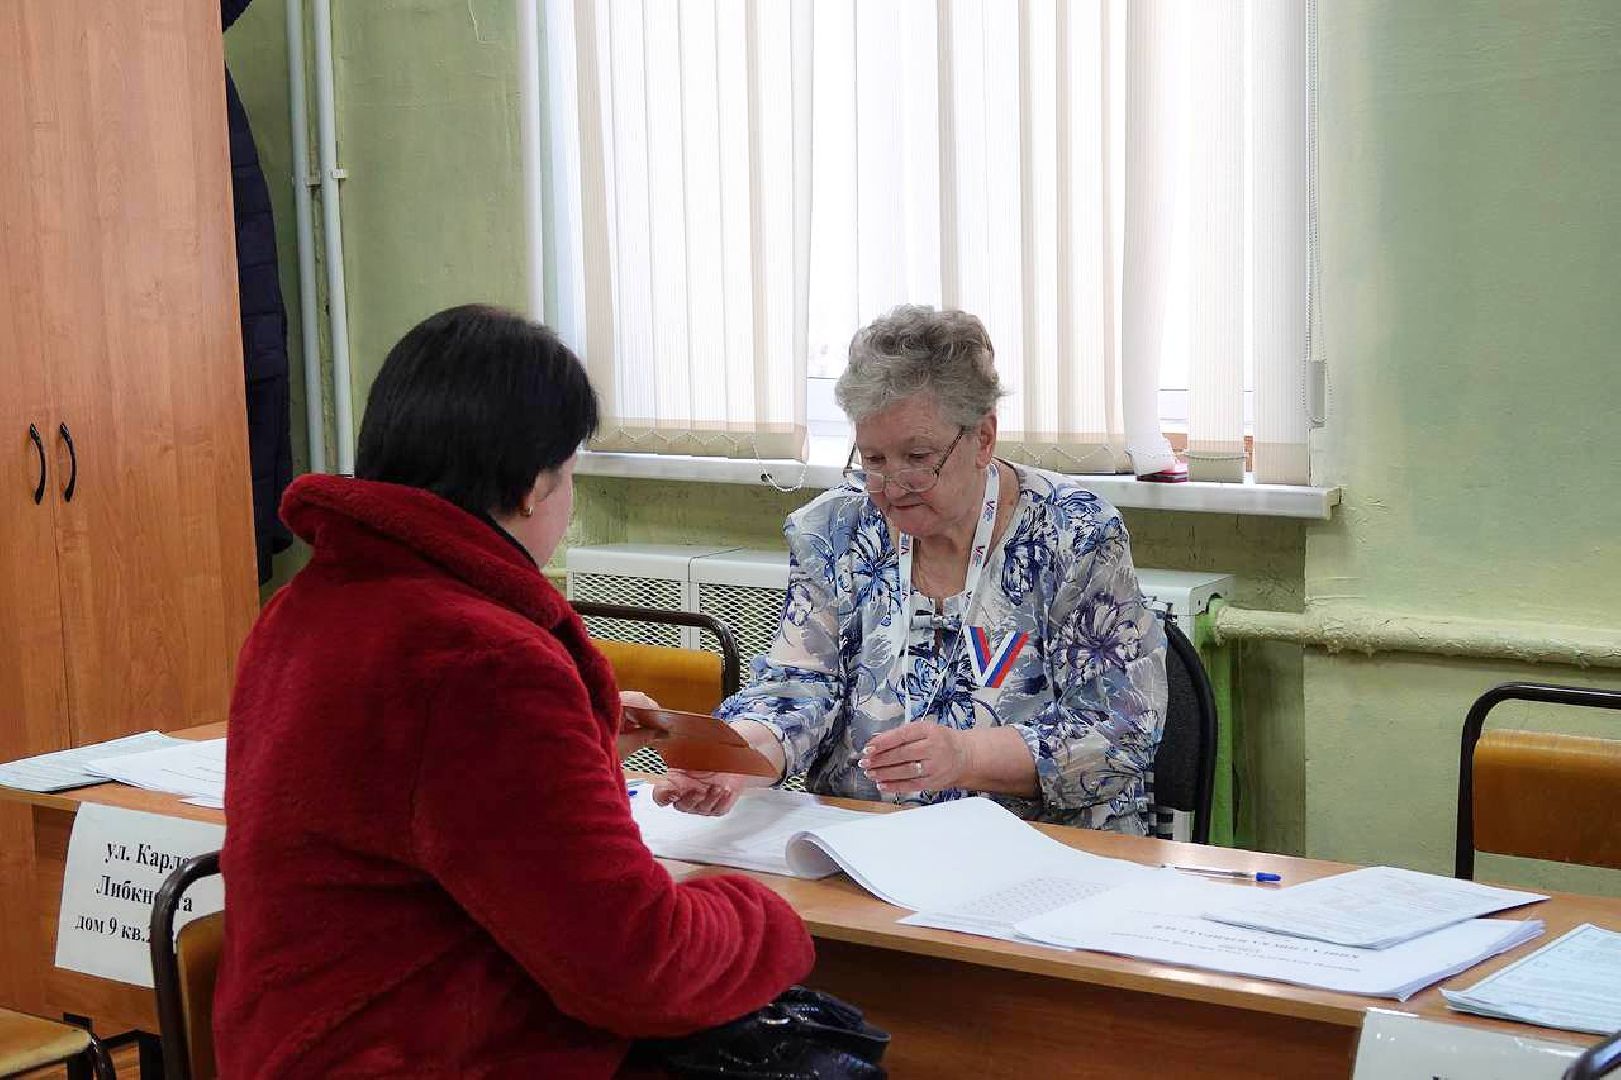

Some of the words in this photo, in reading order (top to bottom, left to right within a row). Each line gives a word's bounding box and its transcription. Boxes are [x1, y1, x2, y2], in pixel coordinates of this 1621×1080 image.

[104, 843, 130, 863] ул.
[75, 915, 104, 934] дом
[109, 916, 118, 936] 9
